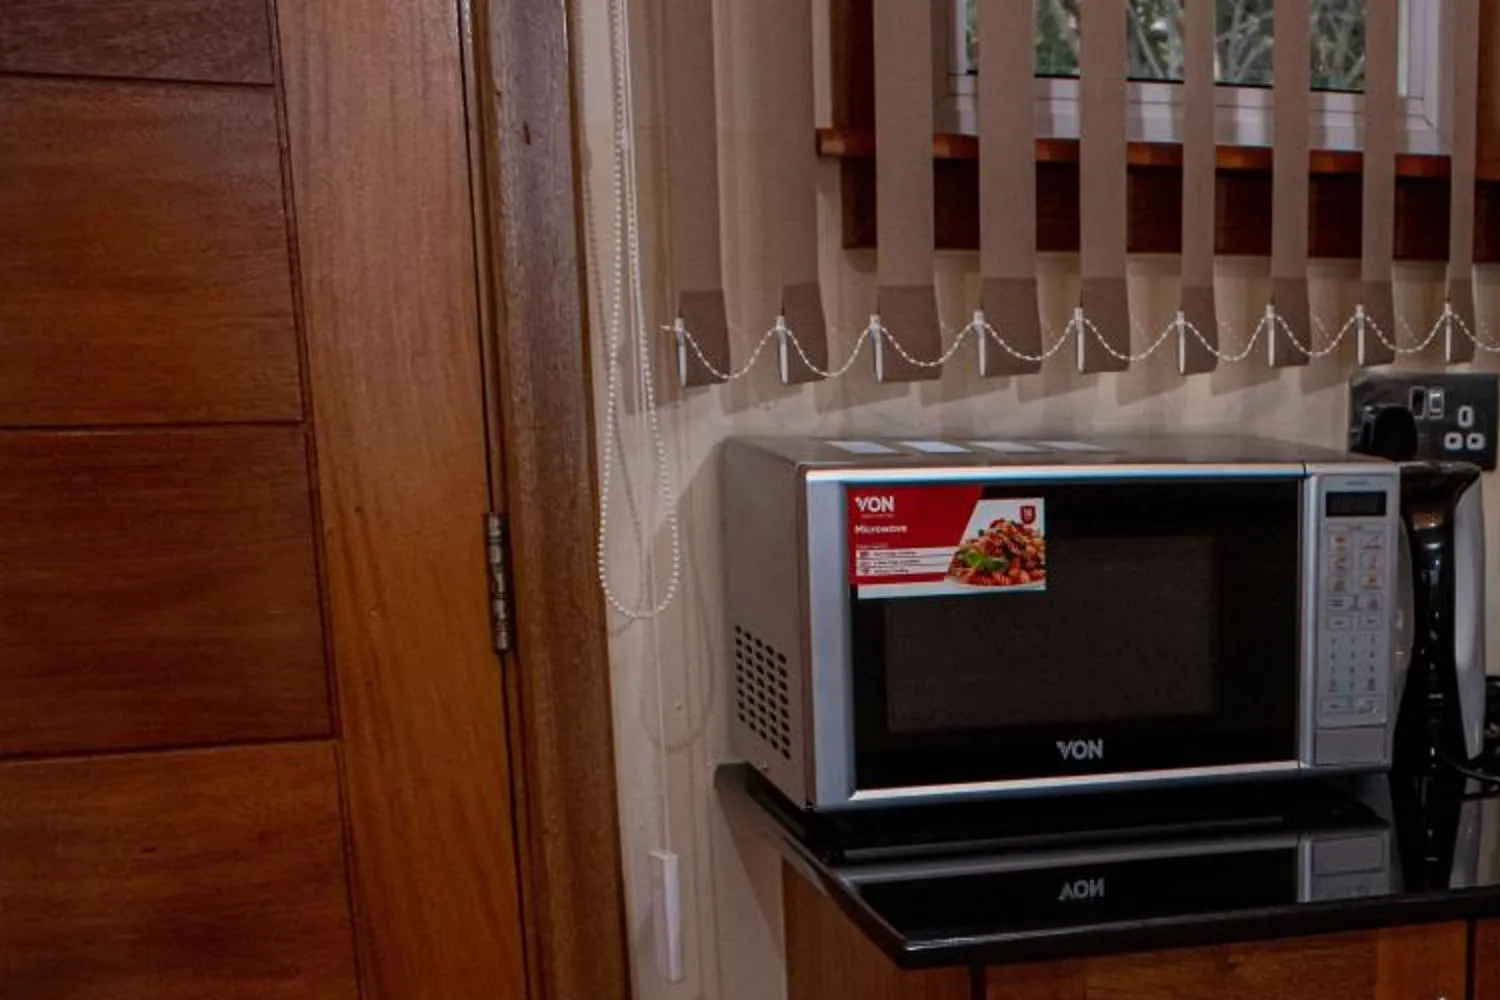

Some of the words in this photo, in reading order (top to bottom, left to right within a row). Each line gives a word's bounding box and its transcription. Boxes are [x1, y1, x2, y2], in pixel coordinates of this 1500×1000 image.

[854, 496, 895, 512] VON
[854, 525, 908, 534] Microwave
[1056, 738, 1104, 760] VON
